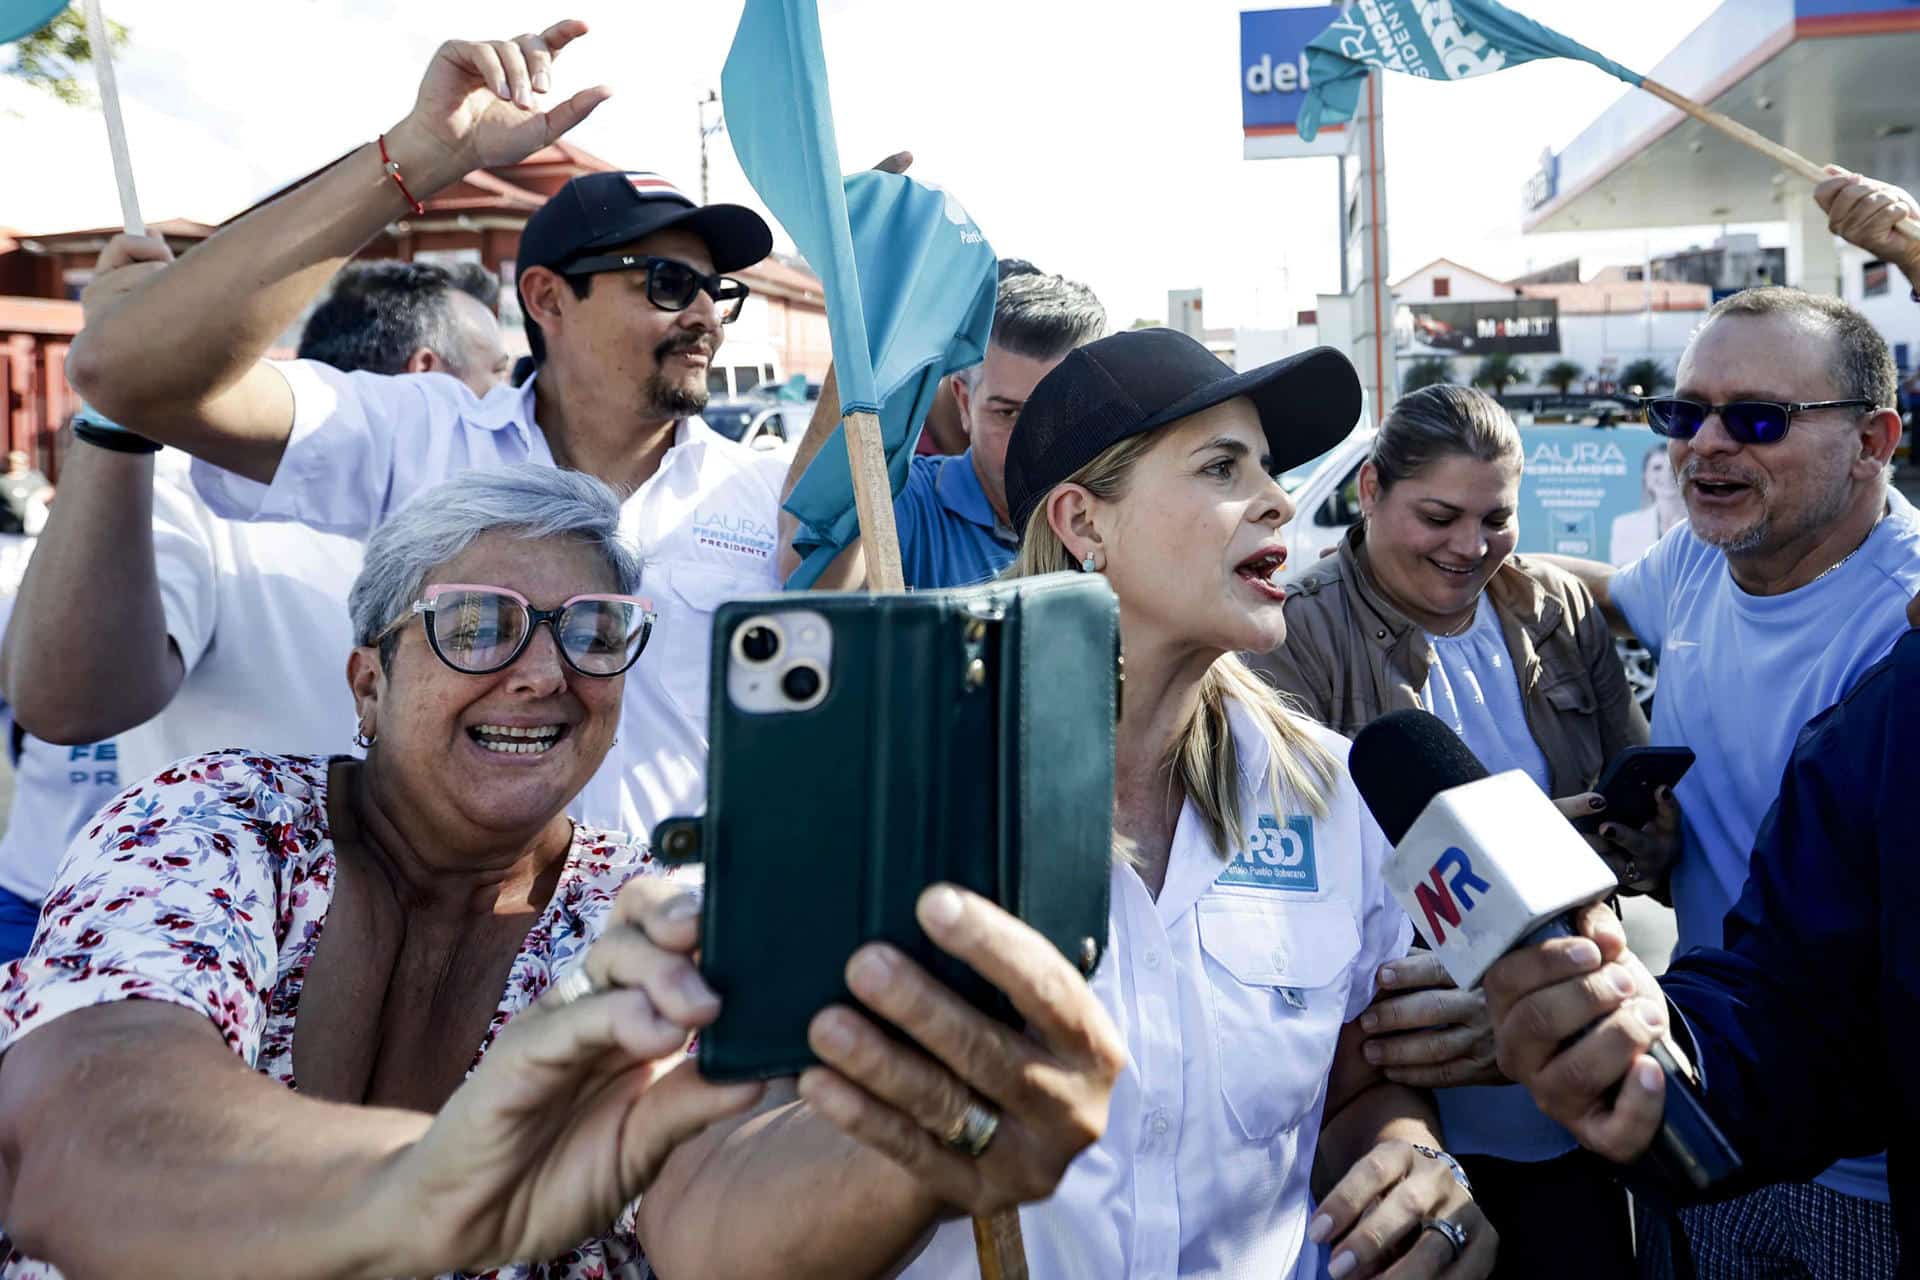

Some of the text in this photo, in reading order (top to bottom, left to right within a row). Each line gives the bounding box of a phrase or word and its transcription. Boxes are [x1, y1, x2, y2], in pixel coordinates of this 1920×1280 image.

[693, 509, 774, 540] LAURA
[700, 537, 768, 558] PRESIDENTE
[1414, 846, 1491, 945] NR
